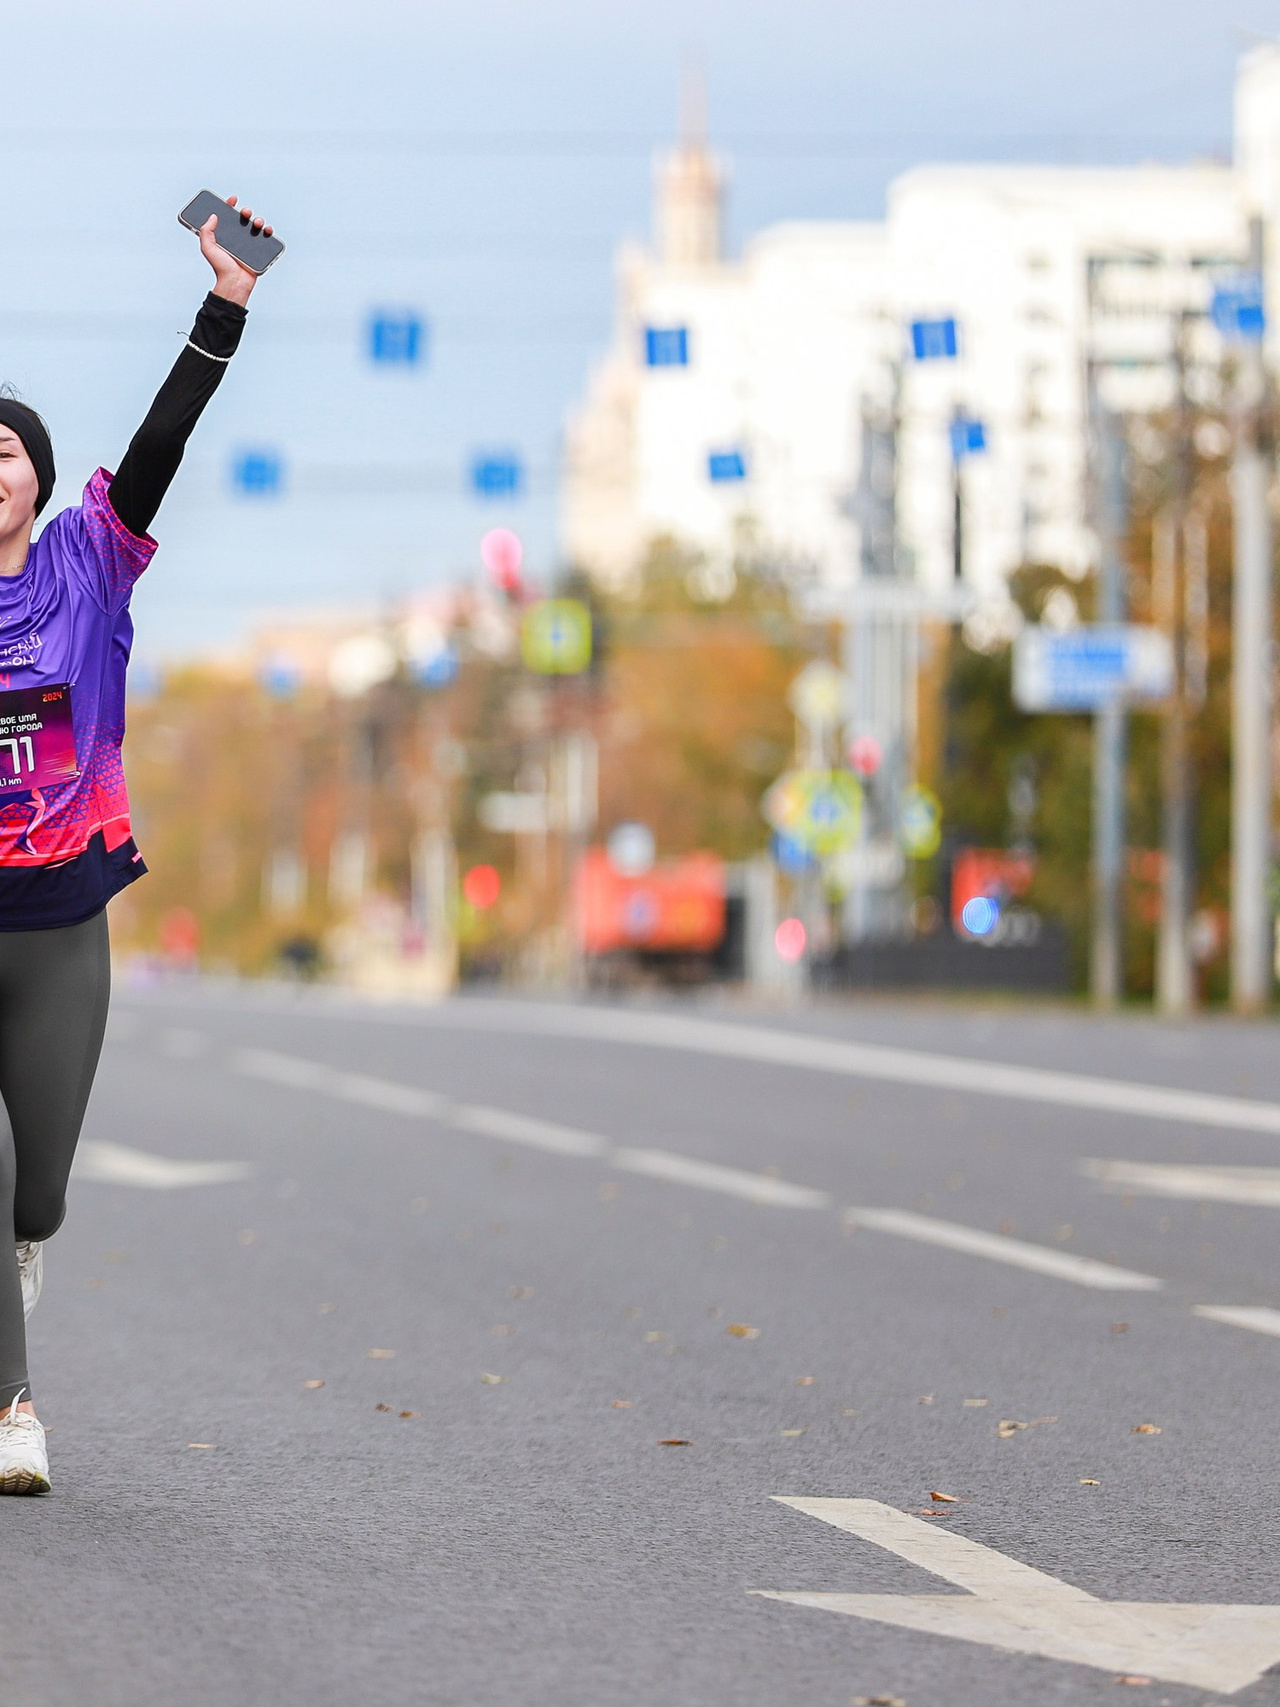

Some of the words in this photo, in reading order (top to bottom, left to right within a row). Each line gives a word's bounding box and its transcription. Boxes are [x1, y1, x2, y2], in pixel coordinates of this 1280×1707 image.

[42, 691, 63, 702] 2024
[18, 713, 37, 723] ИМЯ
[11, 722, 43, 733] ГОРОДА
